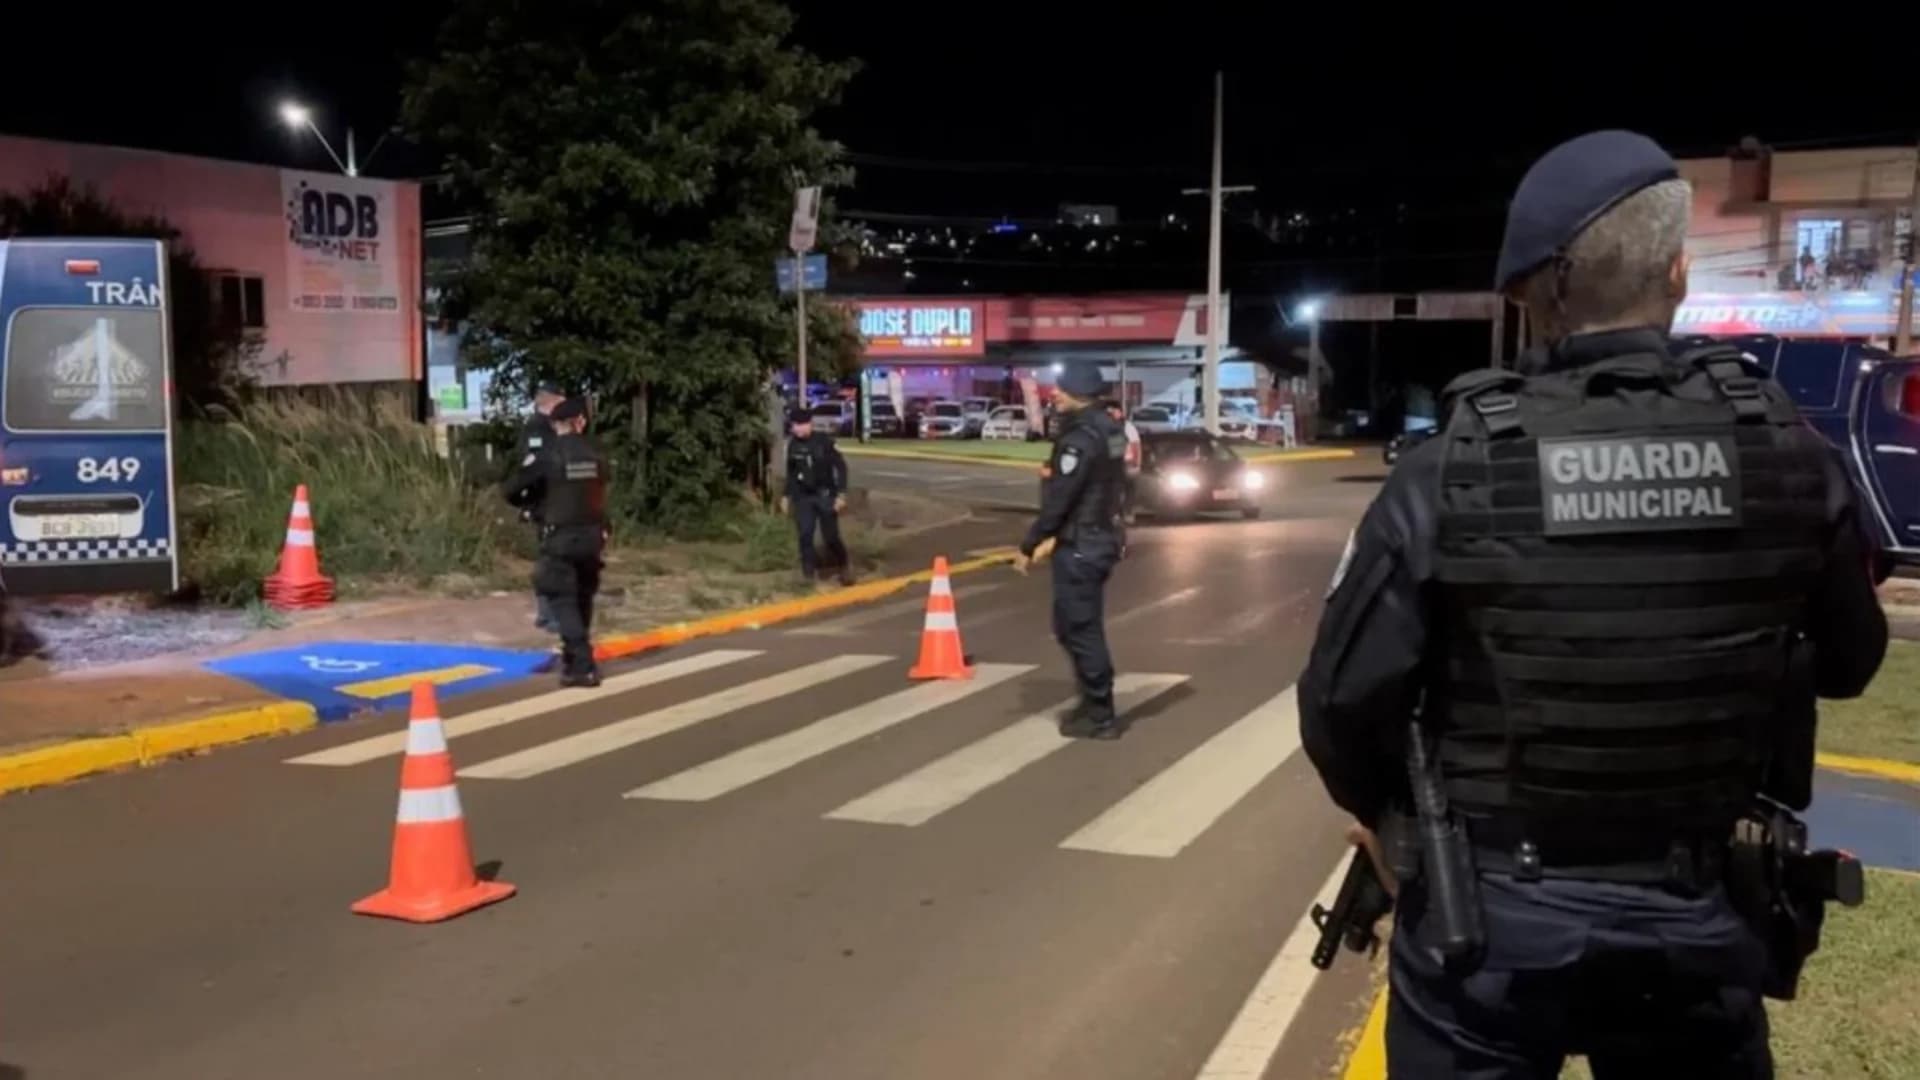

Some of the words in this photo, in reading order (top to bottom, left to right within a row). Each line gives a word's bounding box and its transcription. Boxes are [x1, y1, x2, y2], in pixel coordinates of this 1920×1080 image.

[302, 189, 379, 239] ADB
[339, 240, 380, 261] NET
[911, 307, 972, 336] DUPLA
[77, 456, 141, 483] 849
[1550, 441, 1731, 484] GUARDA
[1551, 486, 1733, 522] MUNICIPAL
